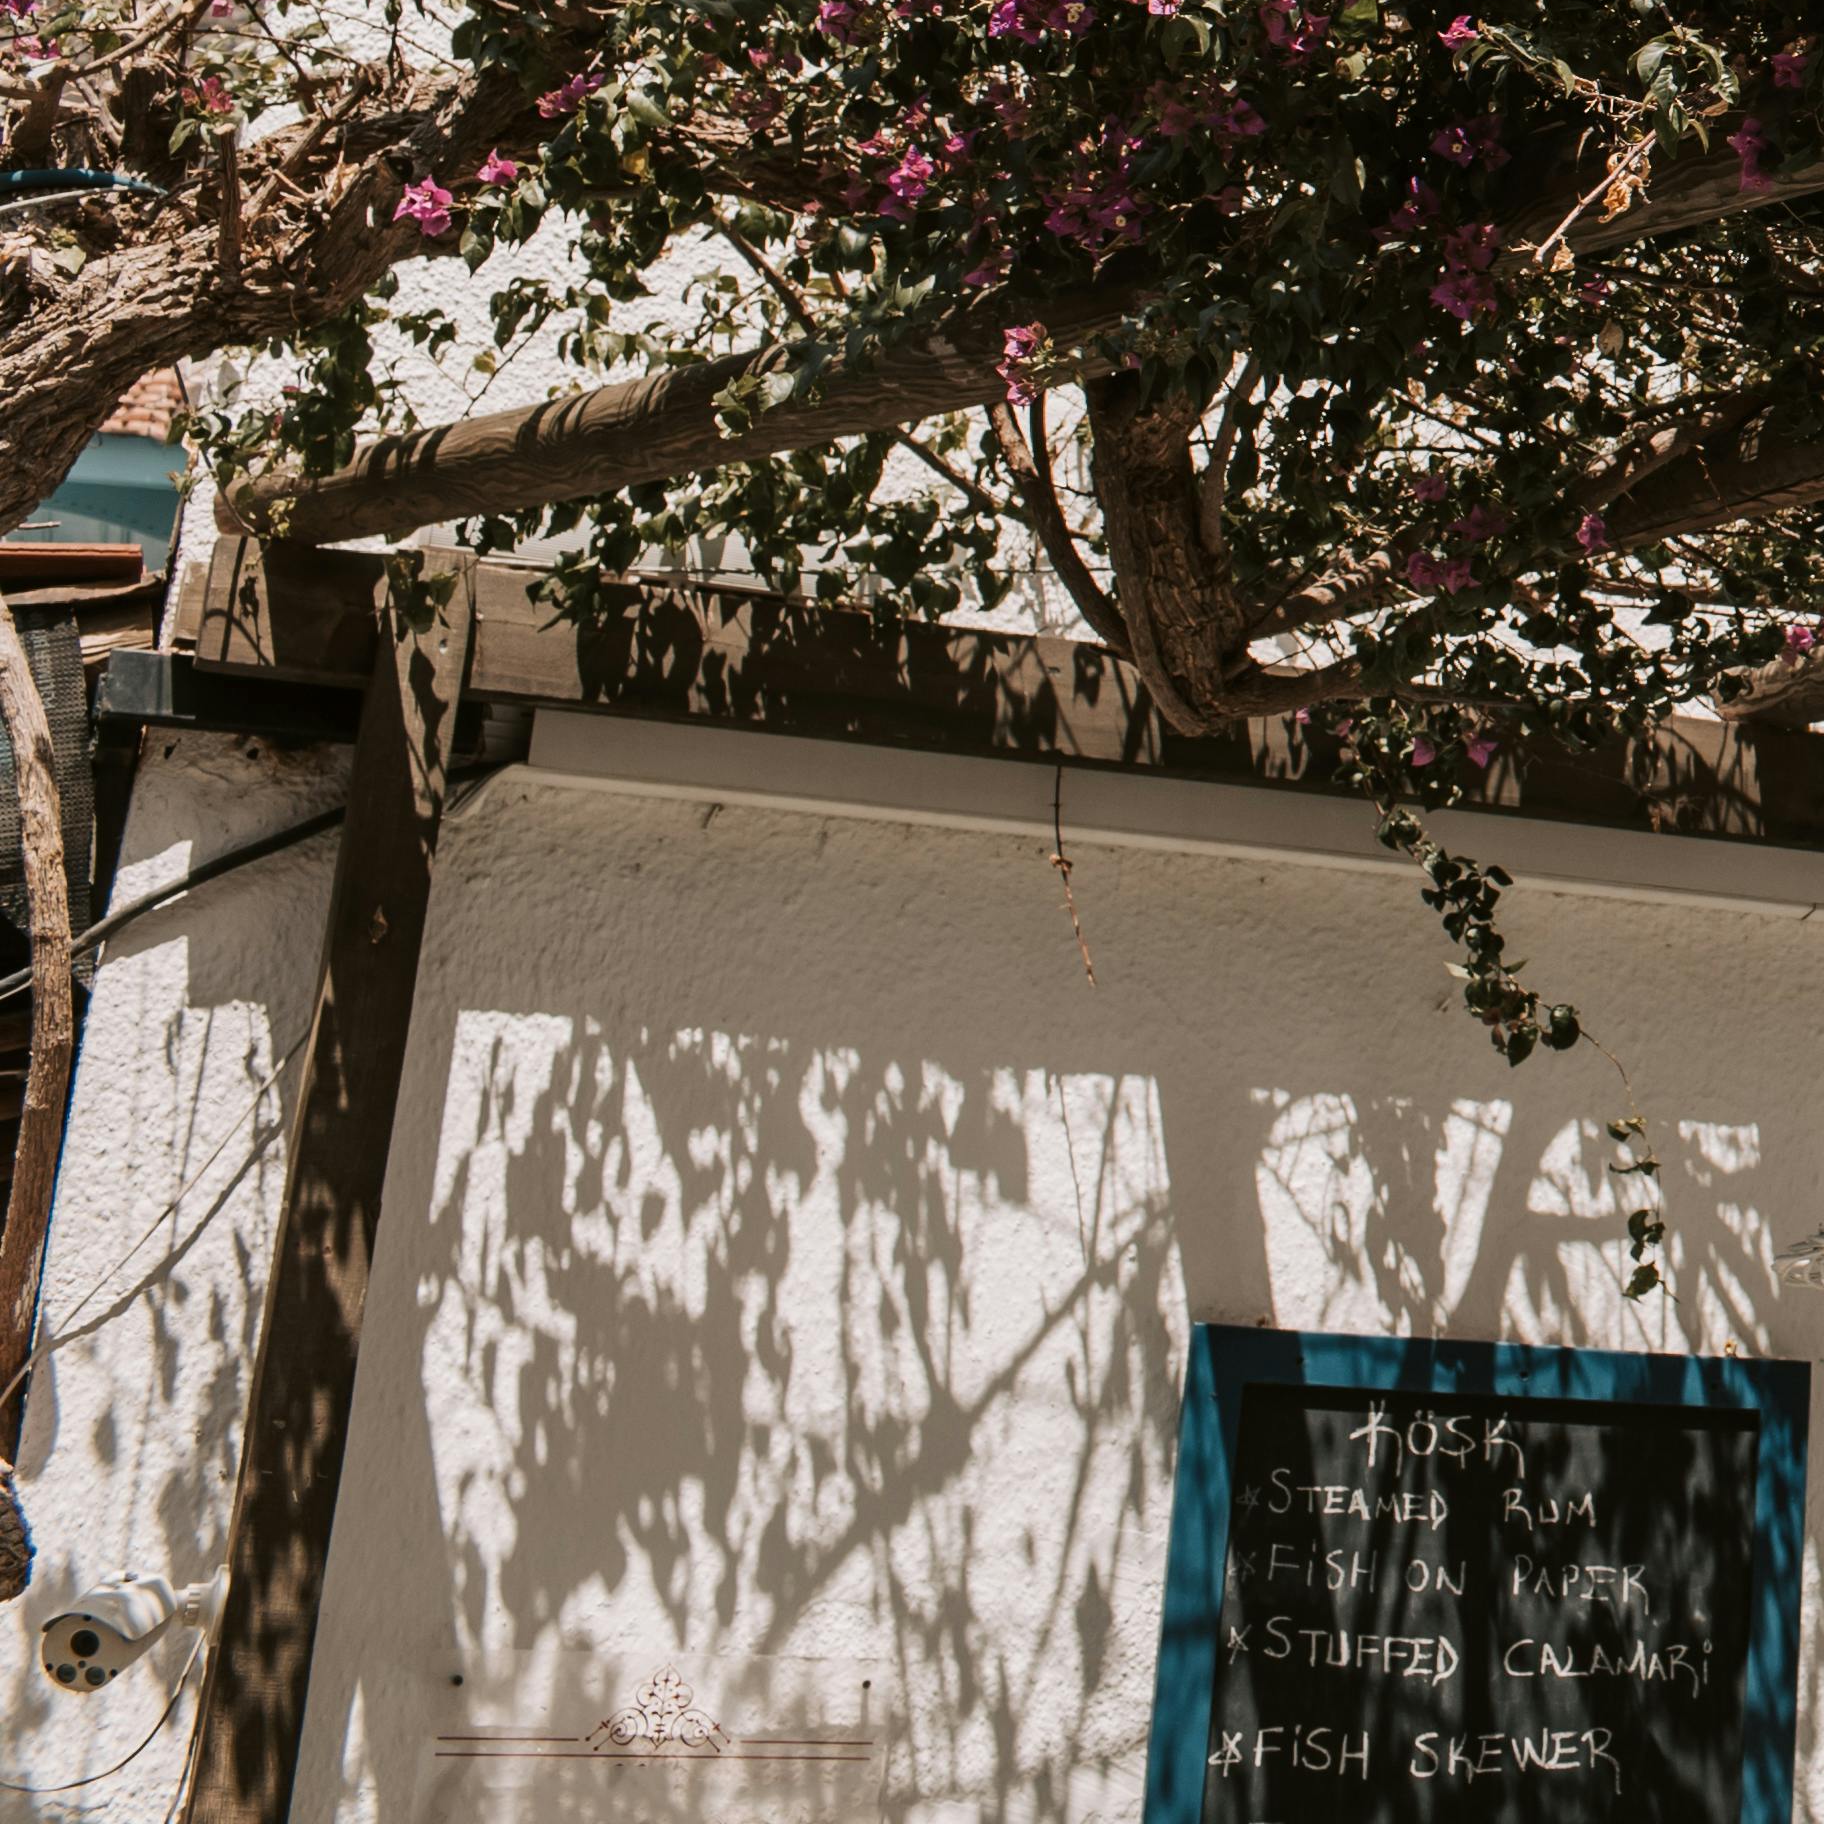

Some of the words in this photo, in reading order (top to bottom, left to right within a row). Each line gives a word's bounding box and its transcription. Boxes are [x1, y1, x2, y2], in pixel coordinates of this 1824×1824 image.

[1268, 1468, 1449, 1530] STEAMED
[1405, 1558, 1467, 1596] ON
[1512, 1554, 1649, 1616] PAPER
[1263, 1616, 1460, 1687] STUFFED
[1409, 1727, 1622, 1795] SKEWER
